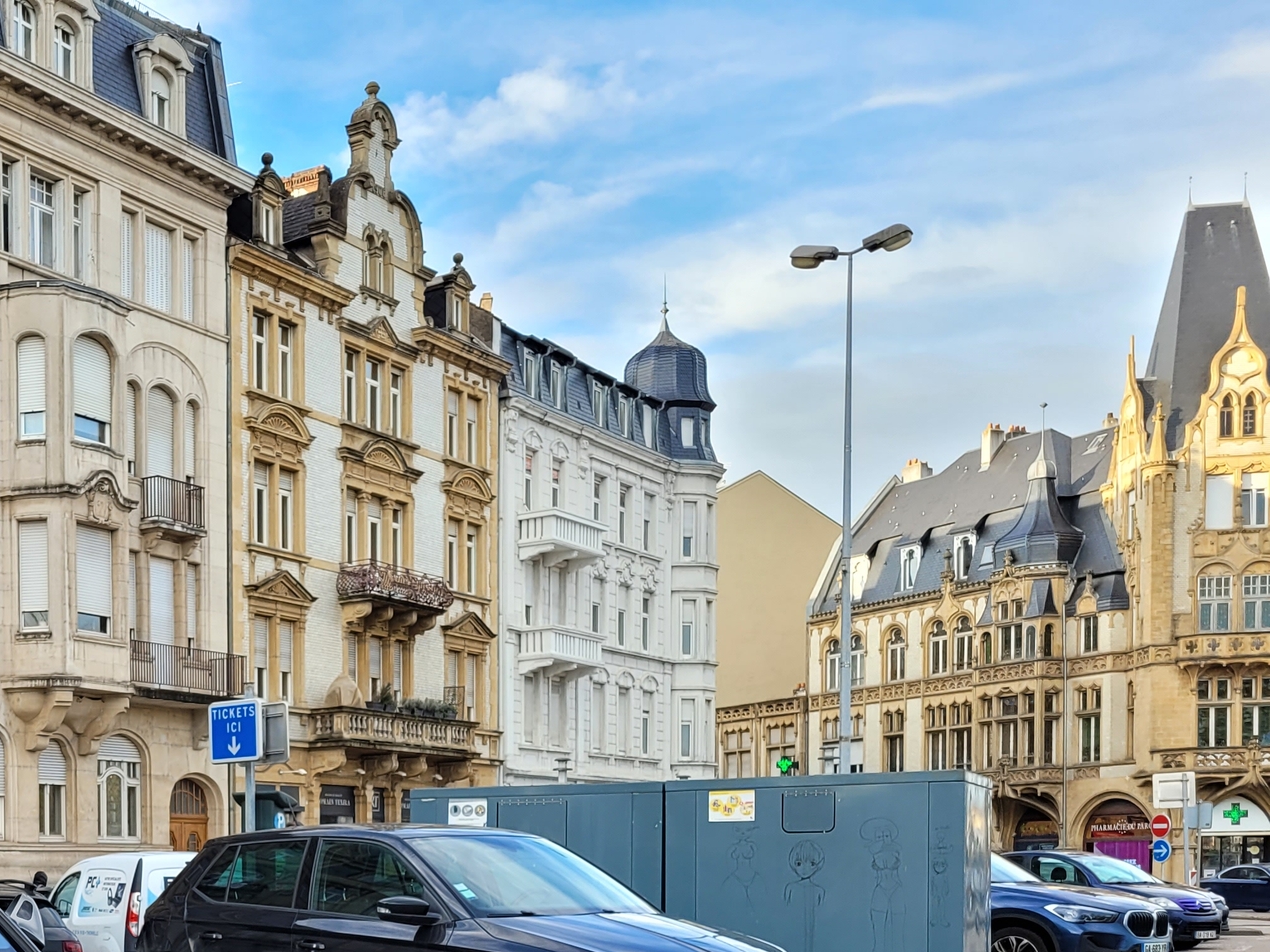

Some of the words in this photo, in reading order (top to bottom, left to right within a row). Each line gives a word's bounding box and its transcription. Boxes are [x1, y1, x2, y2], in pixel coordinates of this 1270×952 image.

[212, 706, 255, 720] TICKETS
[227, 721, 241, 733] ICI
[1091, 822, 1127, 831] PHARMACIE
[1128, 822, 1136, 830] DU
